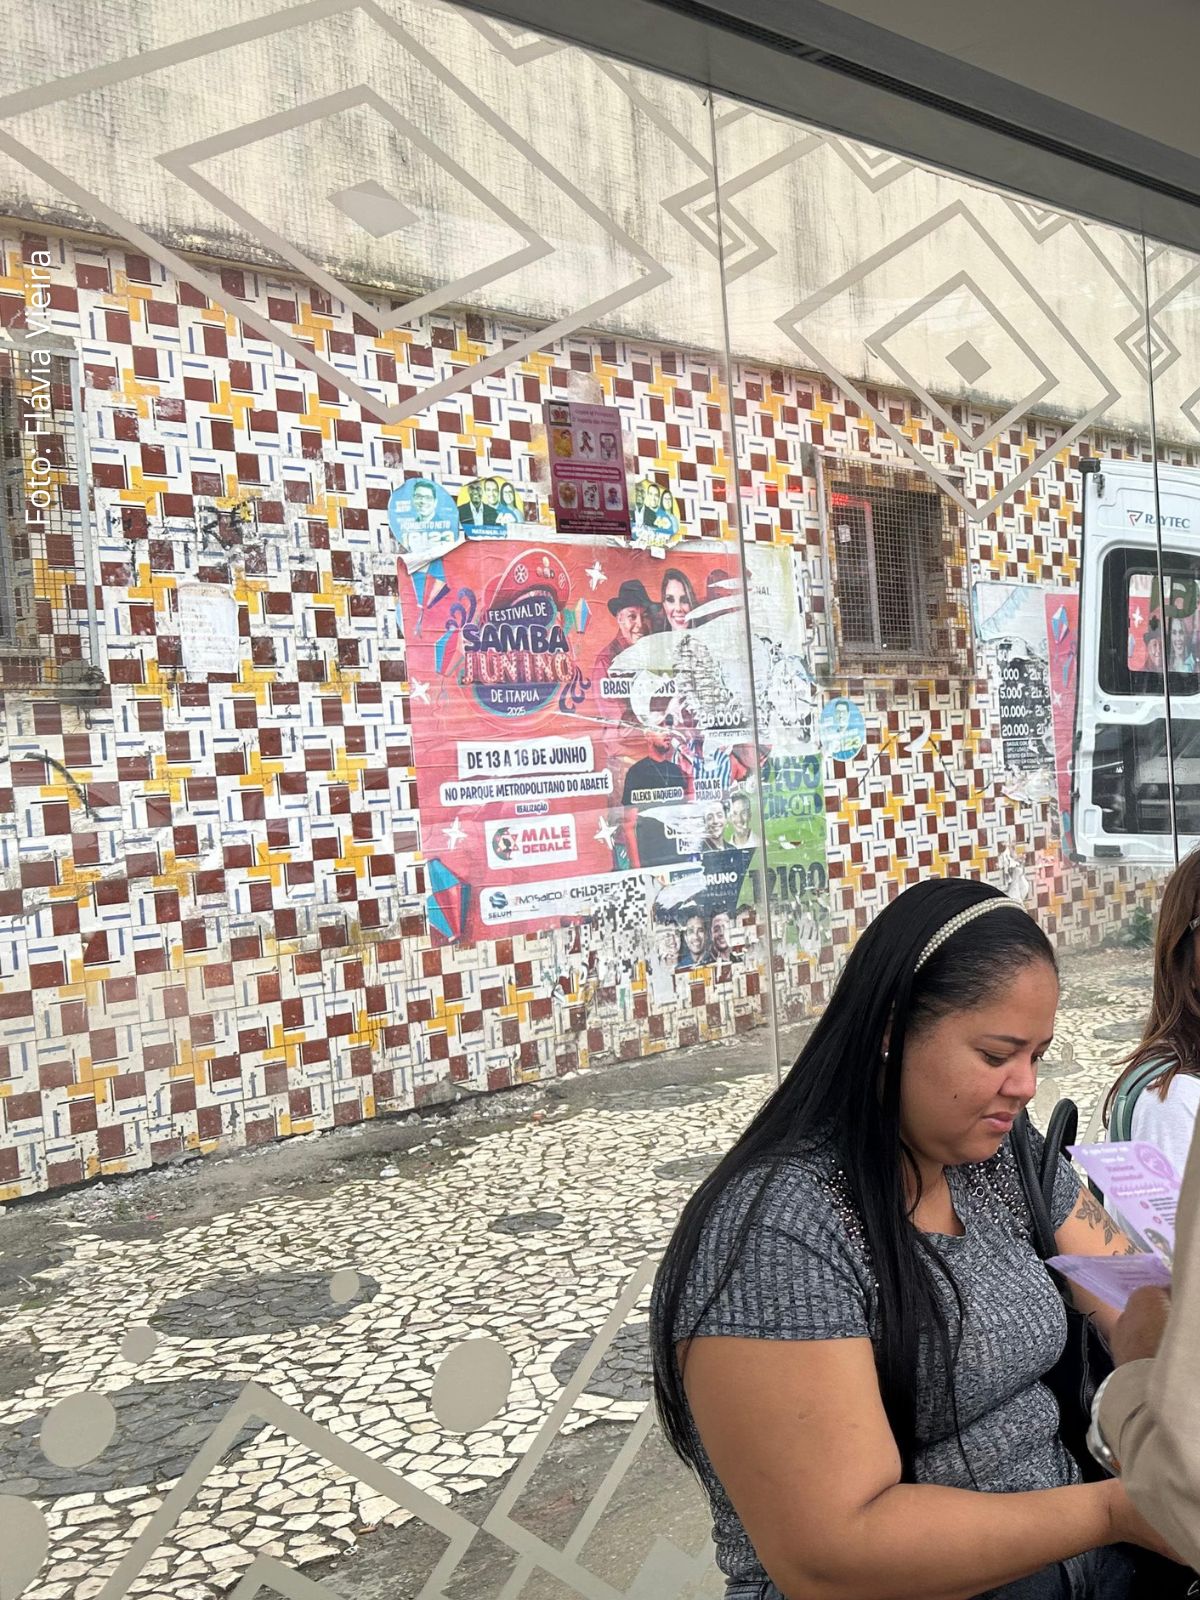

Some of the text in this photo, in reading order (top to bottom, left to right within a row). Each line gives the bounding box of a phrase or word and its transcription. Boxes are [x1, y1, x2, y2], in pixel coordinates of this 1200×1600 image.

[1145, 514, 1190, 528] RYTEC
[489, 602, 548, 622] FESTIVAL DE
[462, 623, 570, 654] SAMBA
[462, 652, 574, 684] JUNINO
[999, 668, 1019, 680] .000
[490, 689, 504, 703] DE
[603, 680, 631, 695] BRASI
[507, 706, 526, 716] 2025
[467, 746, 587, 770] DE 13 A 16 DE JUNHO
[445, 774, 609, 801] NO PARQUE METROPOLITANO DO ABAETÉ
